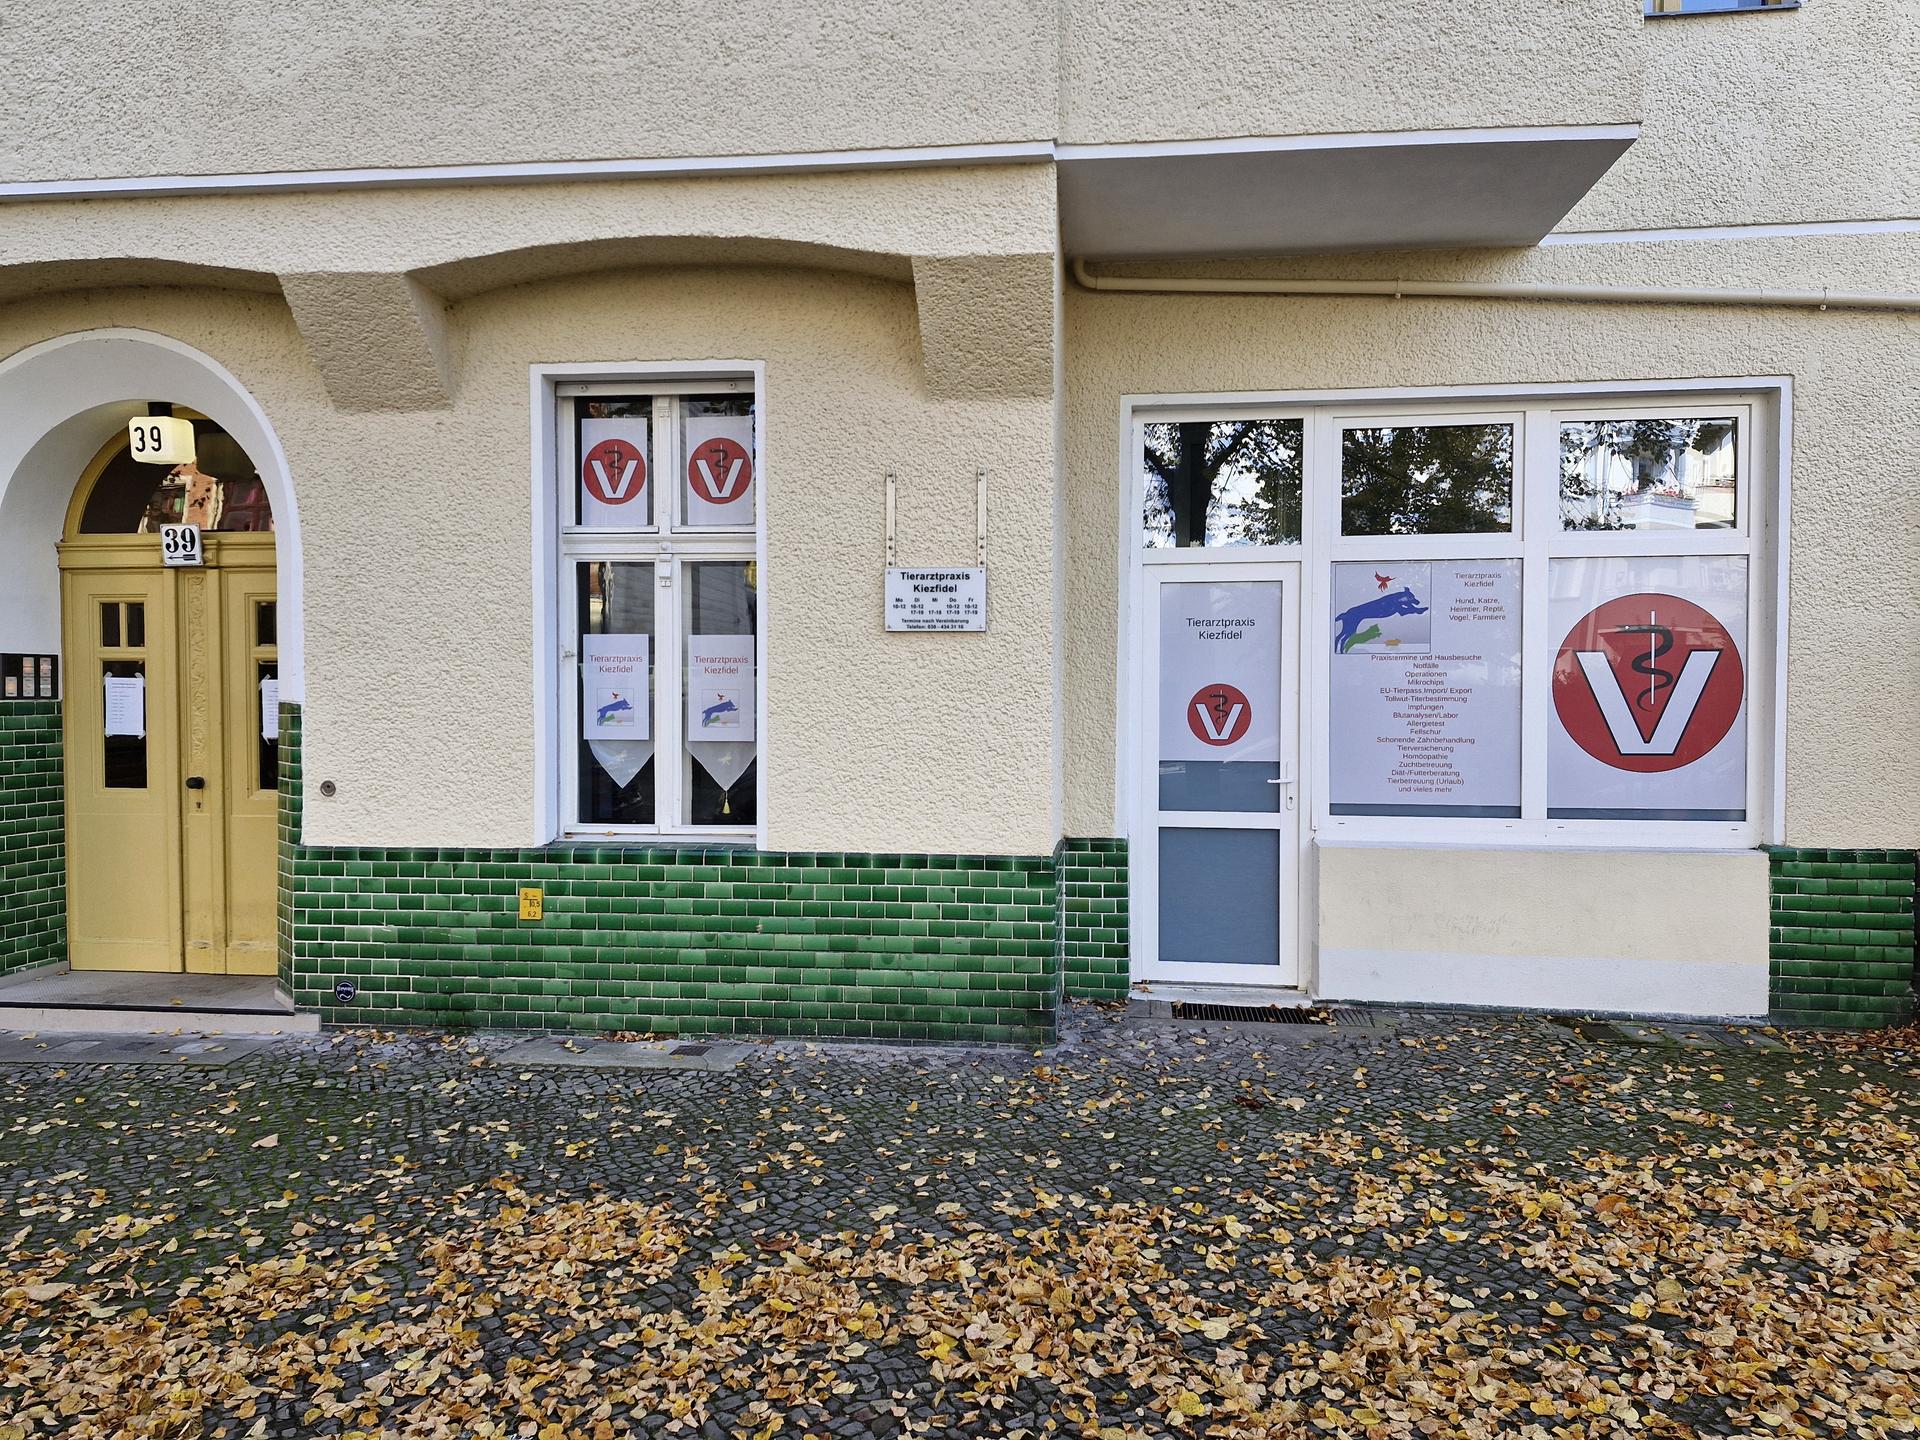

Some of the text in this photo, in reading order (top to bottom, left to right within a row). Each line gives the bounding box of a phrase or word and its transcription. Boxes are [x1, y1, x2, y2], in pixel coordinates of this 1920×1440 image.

[133, 425, 162, 452] 39
[164, 527, 196, 553] 39
[900, 571, 970, 582] Tierarztpraxis
[1455, 572, 1502, 580] Tierarztpraxis
[913, 584, 957, 593] Kiezfidel
[1448, 614, 1471, 622] Vogel,
[1186, 617, 1256, 628] Tierarztpraxis
[1199, 630, 1242, 640] Kiezfidel
[589, 654, 643, 663] Tierarztpraxis
[694, 655, 749, 664] Tierarztpraxis
[599, 664, 633, 673] Kiezfidel
[704, 666, 739, 674] Kiezfidel
[1450, 687, 1473, 695] Export
[1385, 695, 1468, 703] Tollwut-Titerbestimmung
[1406, 720, 1445, 728] Allergietest
[1417, 736, 1475, 744] Zahnbehandlung
[1397, 745, 1454, 753] Tierversicherung
[1398, 761, 1453, 769] Zuchtbetreuung
